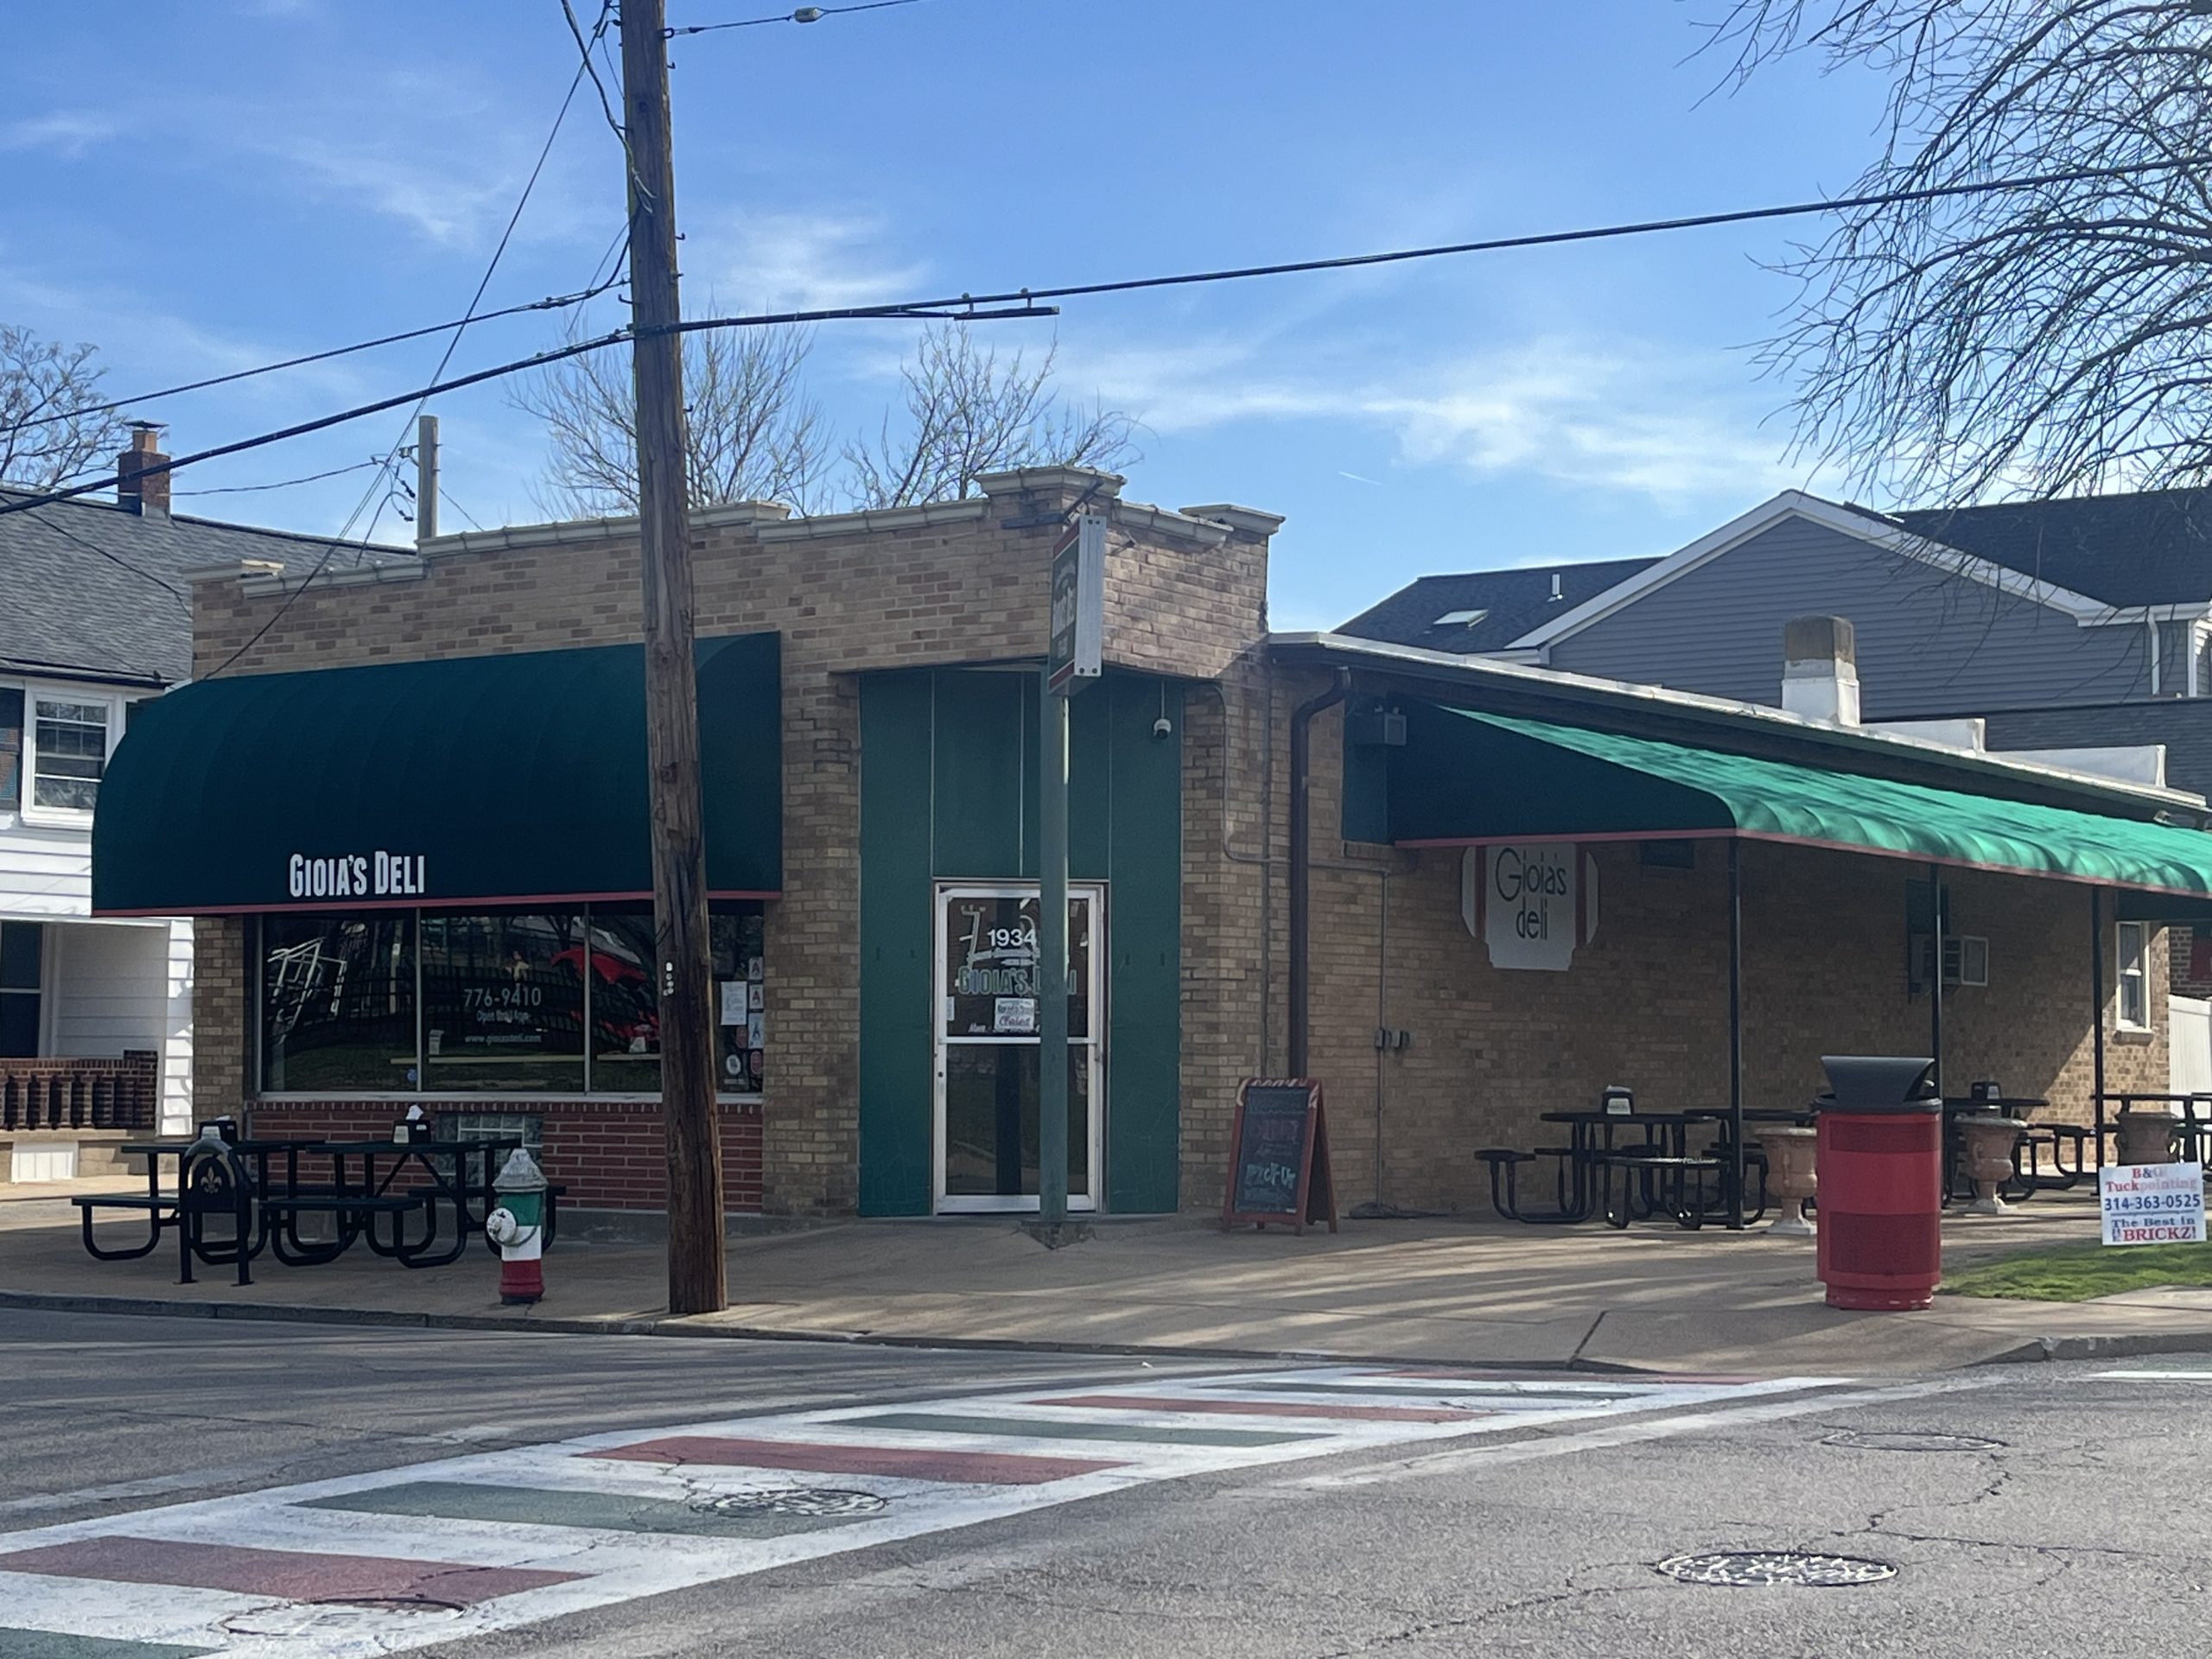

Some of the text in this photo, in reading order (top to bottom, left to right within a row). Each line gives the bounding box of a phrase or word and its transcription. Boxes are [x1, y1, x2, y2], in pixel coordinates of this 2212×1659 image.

[289, 850, 425, 898] GIOIA'S DELI
[1496, 848, 1567, 901] Gioia's
[1516, 896, 1548, 940] deli
[987, 928, 1037, 947] 1934
[957, 965, 1028, 995] GIOIA'S
[463, 987, 542, 1007] 776-9410
[2105, 1178, 2198, 1193] Tuckpointing
[2104, 1194, 2201, 1211] 314-363-0525
[2112, 1218, 2139, 1228] The
[2144, 1217, 2175, 1227] Best
